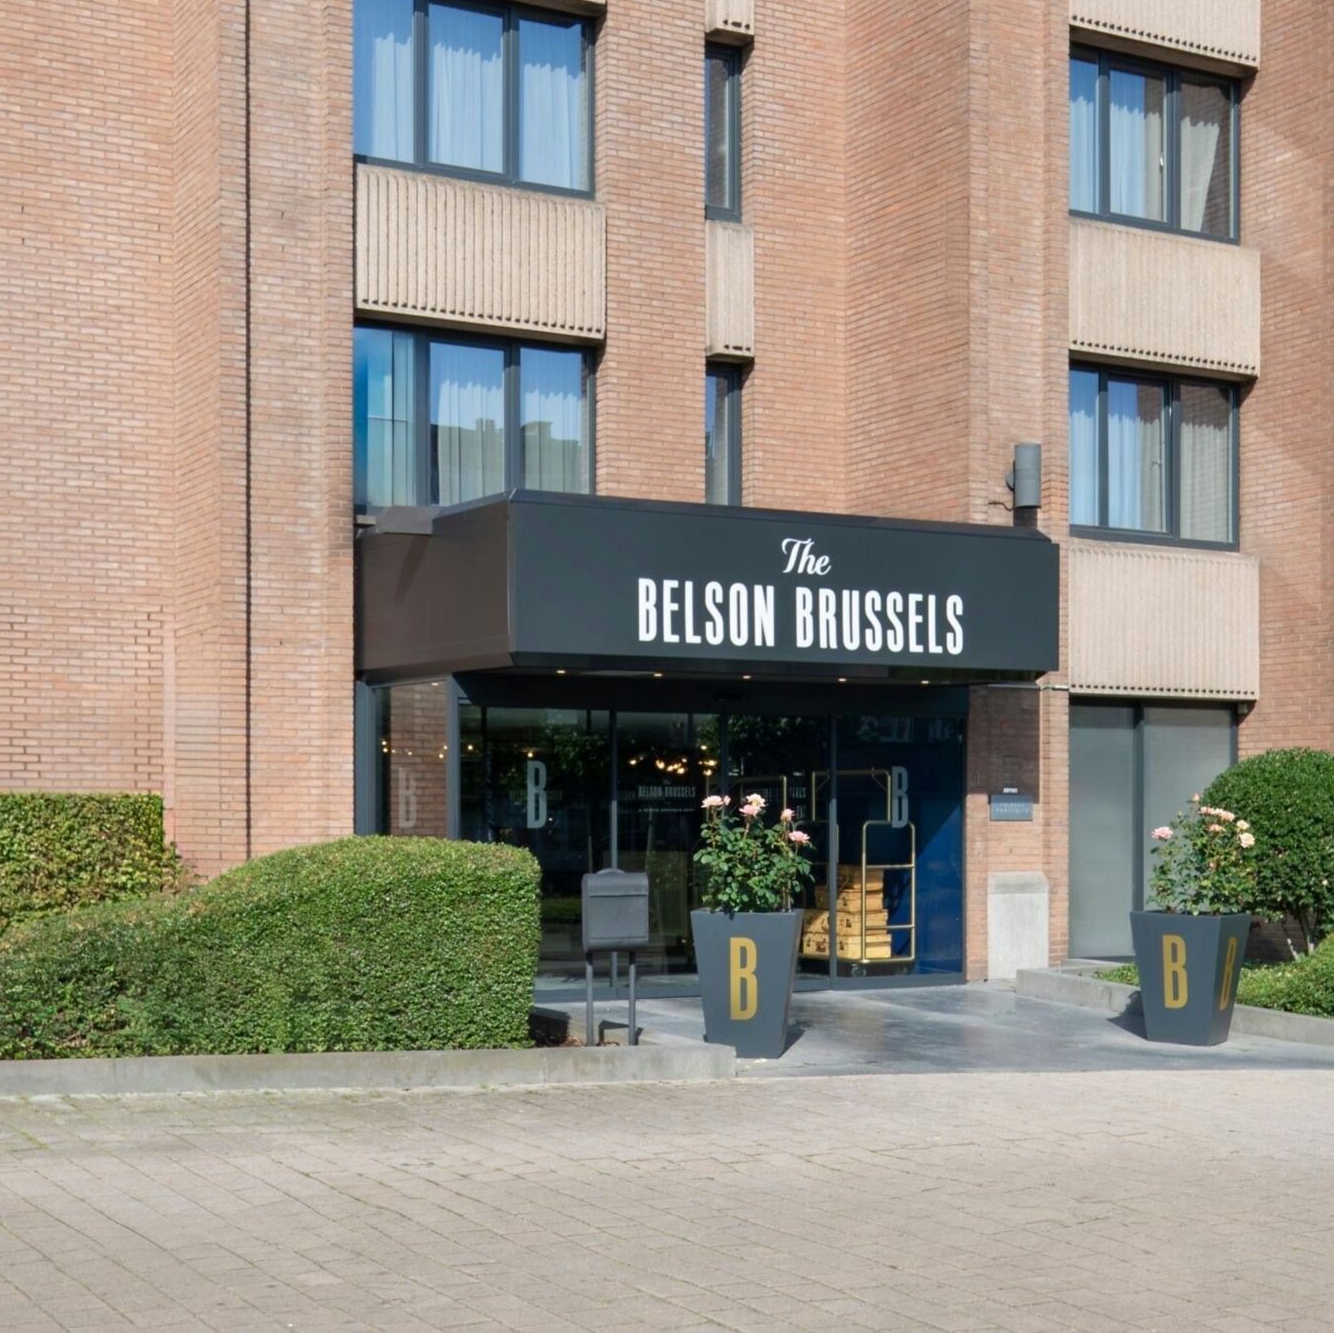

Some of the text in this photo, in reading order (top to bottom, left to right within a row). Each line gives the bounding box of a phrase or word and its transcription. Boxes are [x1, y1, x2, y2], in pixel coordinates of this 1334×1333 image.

[781, 538, 831, 575] The
[638, 577, 964, 655] BELSON BRUSSELS
[527, 760, 547, 829] B
[892, 766, 908, 829] B
[730, 937, 758, 1020] B
[1163, 935, 1188, 1008] B
